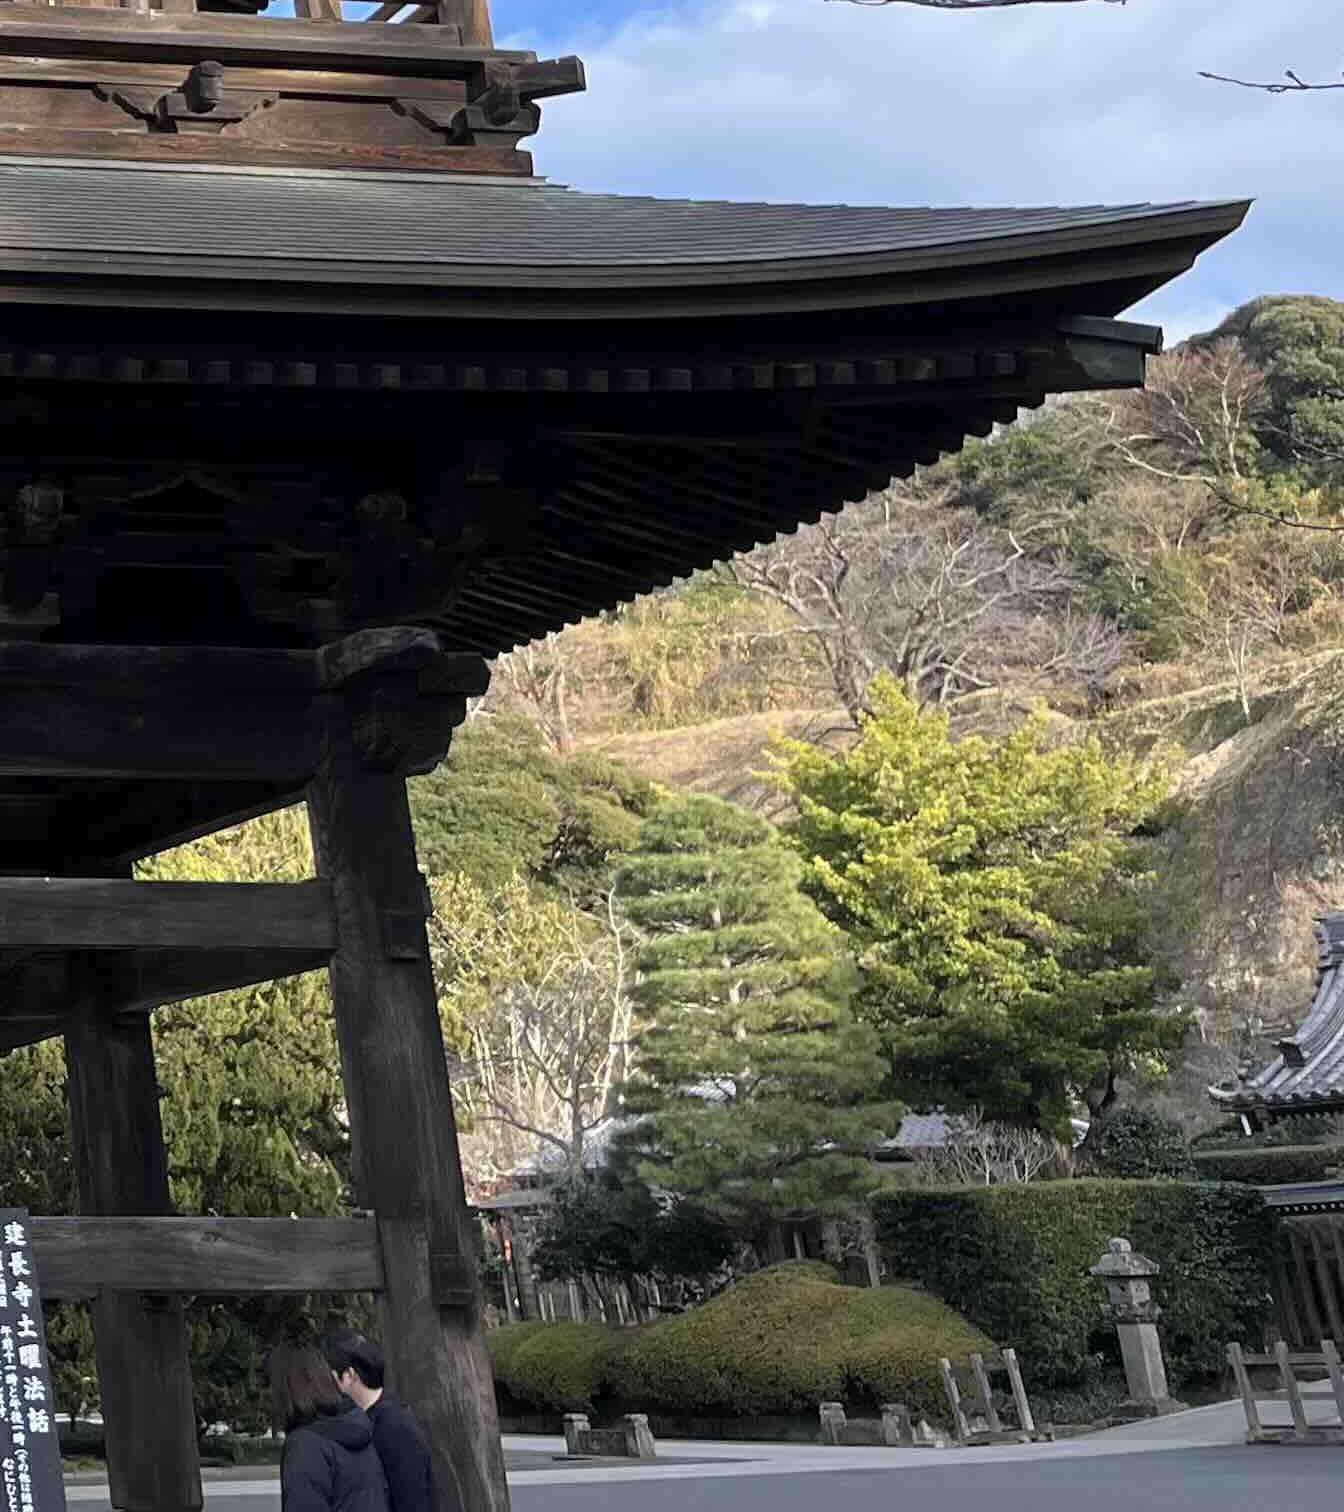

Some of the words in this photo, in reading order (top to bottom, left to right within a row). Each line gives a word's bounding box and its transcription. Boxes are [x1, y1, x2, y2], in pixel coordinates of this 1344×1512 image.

[4, 1221, 50, 1434] 建長寺土曜法話
